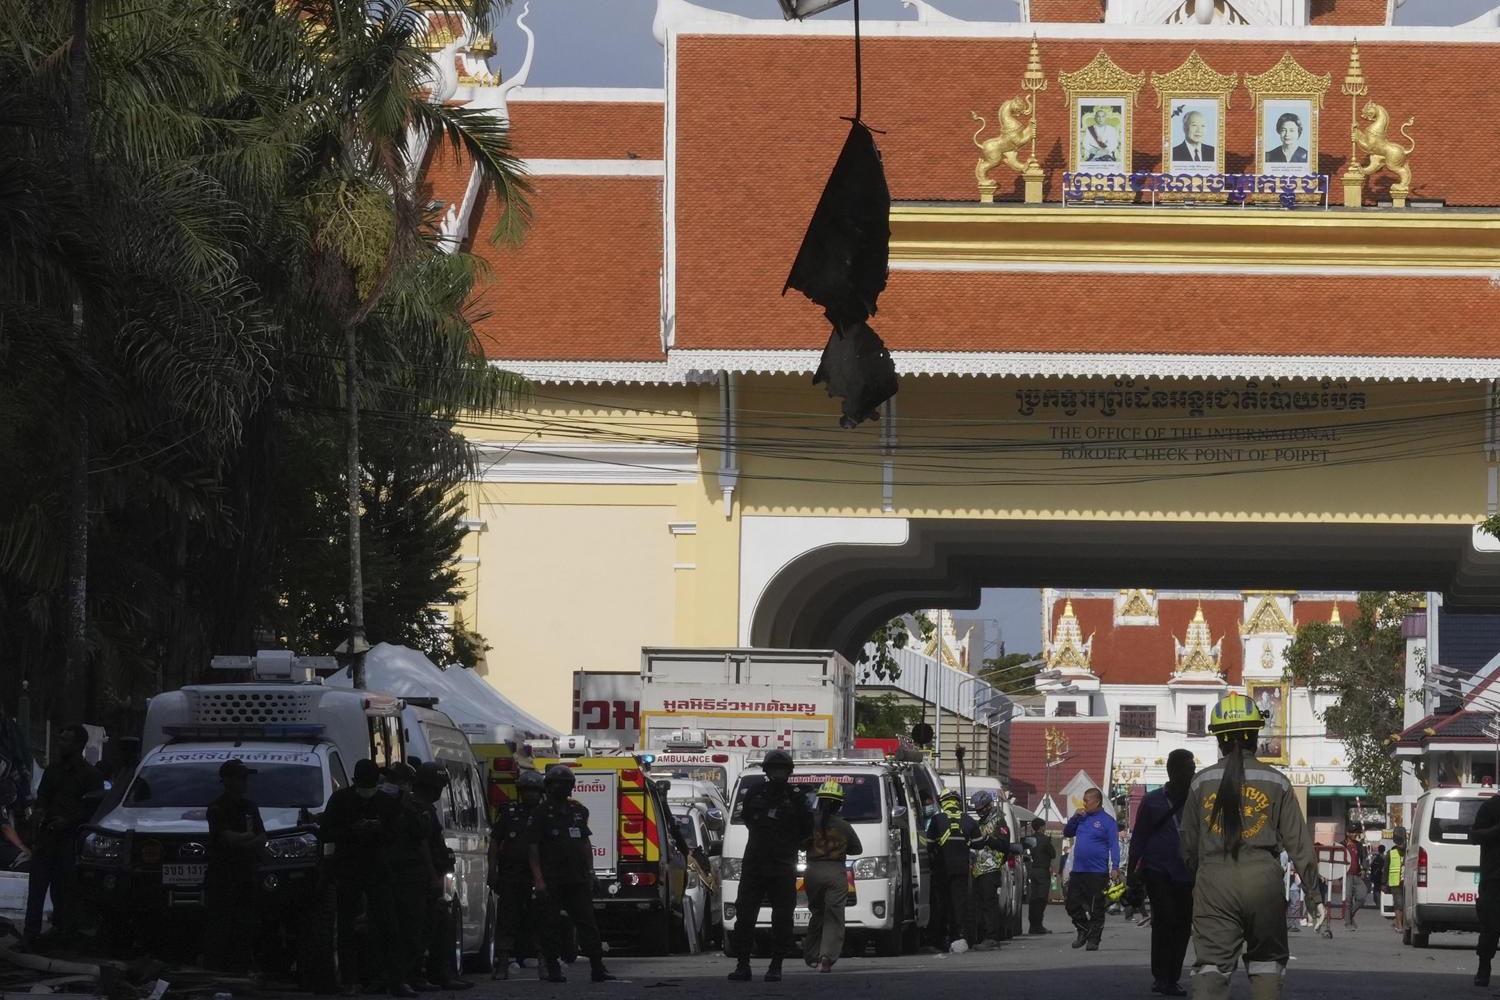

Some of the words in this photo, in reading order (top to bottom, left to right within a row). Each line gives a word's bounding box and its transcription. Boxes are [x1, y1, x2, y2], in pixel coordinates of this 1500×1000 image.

[1049, 426, 1081, 440] THE
[1086, 426, 1141, 441] OFFICE
[1145, 427, 1165, 441] OF
[1170, 427, 1203, 441] THE
[1060, 447, 1127, 461] BORDER
[1133, 448, 1188, 461] CHECK
[1195, 448, 1242, 462] POINT
[1248, 449, 1268, 462] OF
[1275, 449, 1329, 462] POIPET
[657, 755, 710, 763] AMBULANCE
[1287, 772, 1325, 785] AILAND
